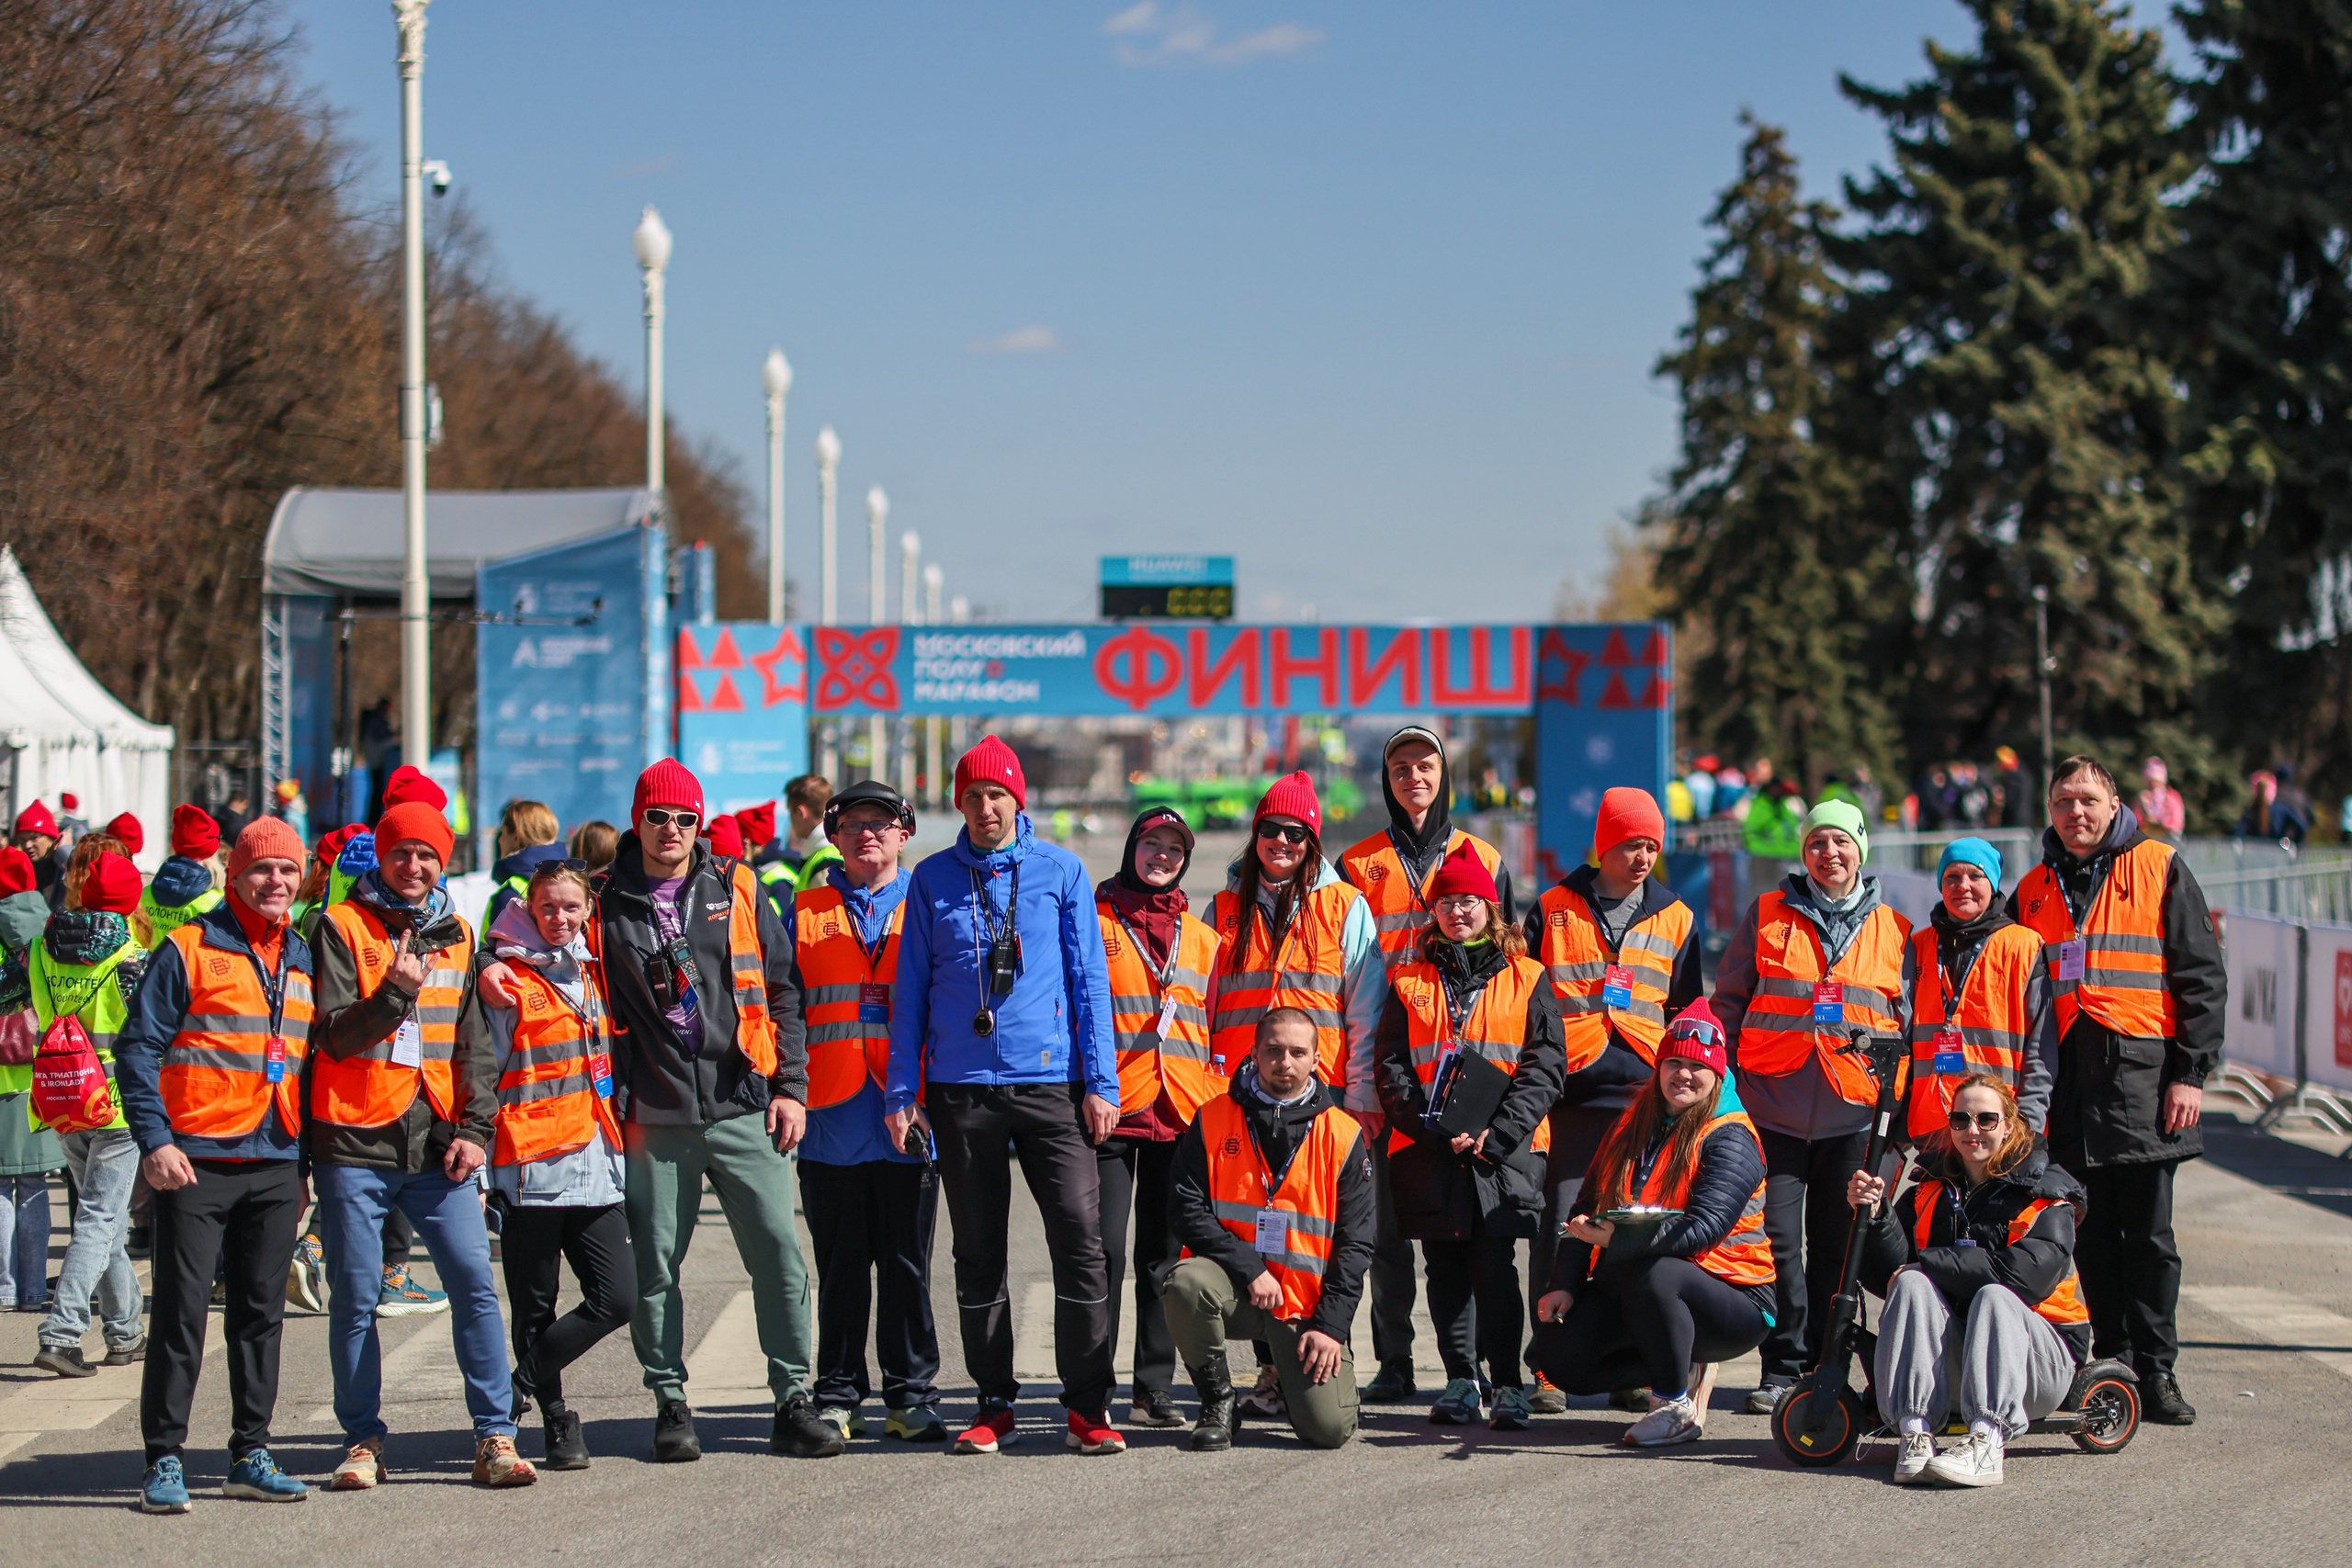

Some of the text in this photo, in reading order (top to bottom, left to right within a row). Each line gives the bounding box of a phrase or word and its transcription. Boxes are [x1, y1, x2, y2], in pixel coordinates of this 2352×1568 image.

[914, 630, 1087, 658] МОСКОВСКИЙ
[1093, 626, 1532, 710] ФИНИШ
[914, 680, 1041, 703] МАРАФОН
[707, 908, 729, 921] КОМАНД
[50, 1066, 96, 1078] ТРИАТЛОНА
[47, 1077, 85, 1088] IRONLADY
